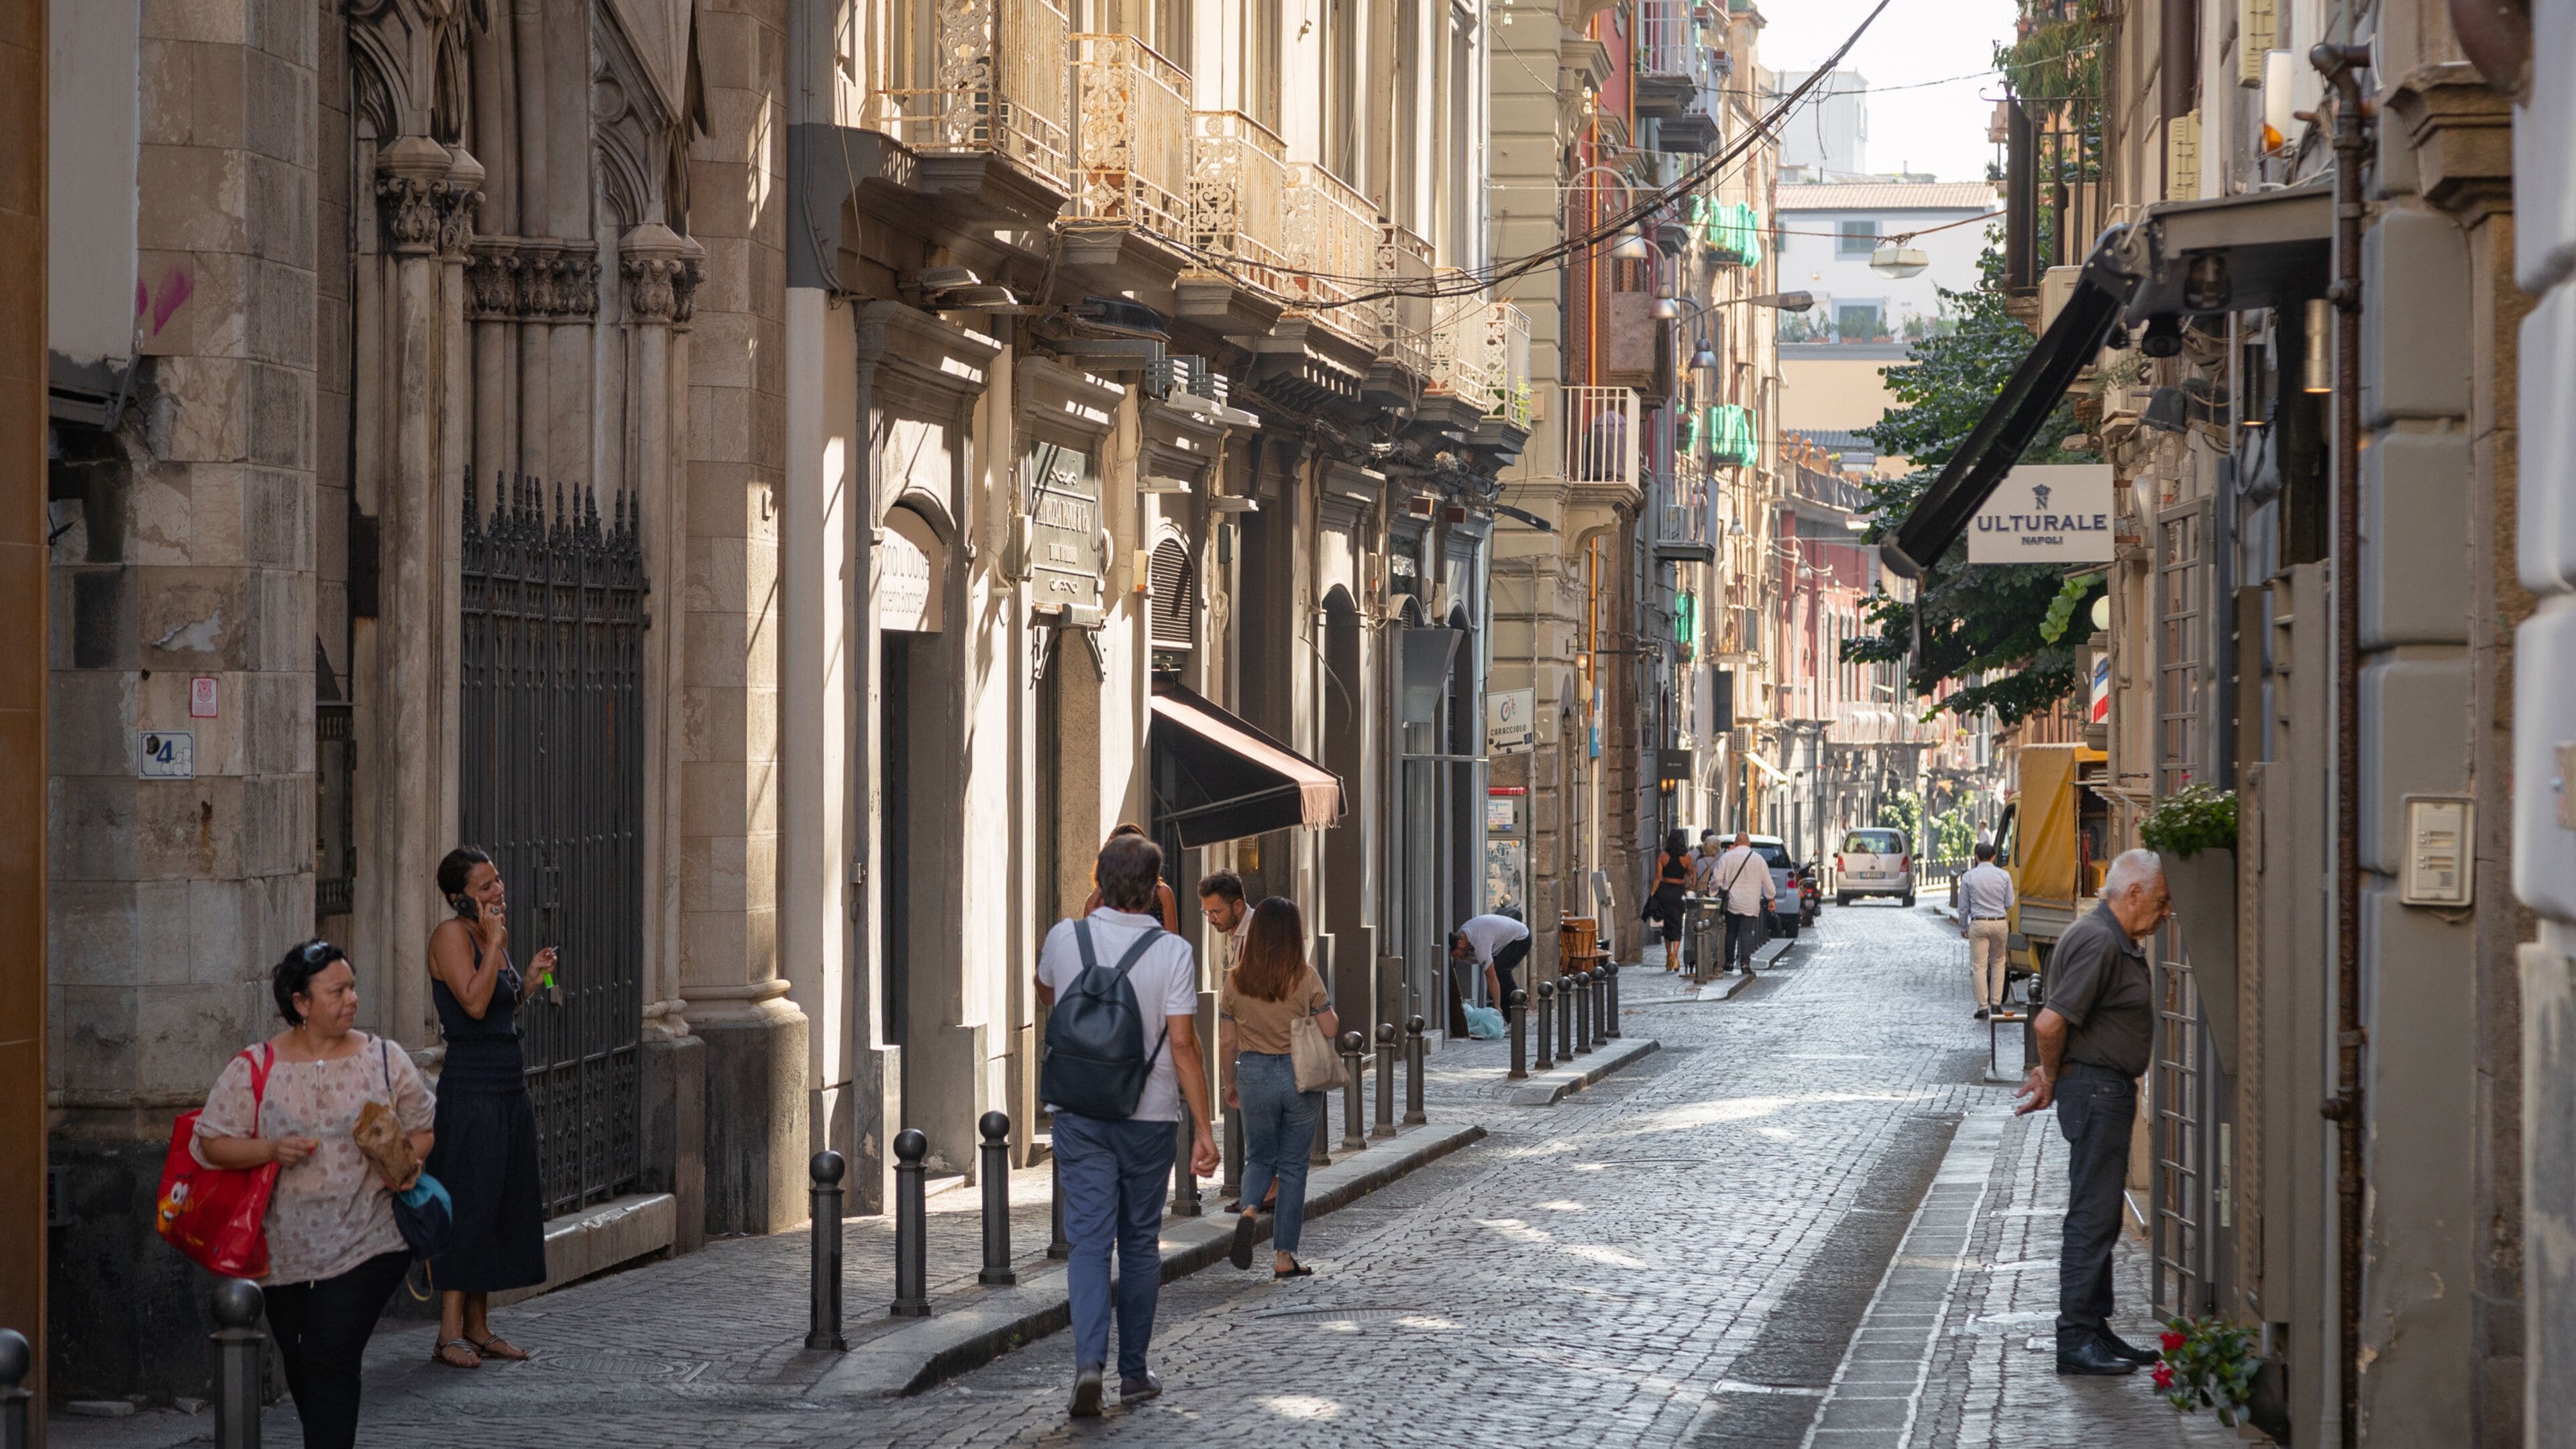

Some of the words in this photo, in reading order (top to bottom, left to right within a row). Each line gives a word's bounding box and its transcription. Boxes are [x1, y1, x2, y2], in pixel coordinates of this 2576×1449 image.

[2035, 496, 2048, 510] N
[1977, 514, 2108, 531] ULTURALE
[2021, 536, 2063, 545] NAPOLI
[1490, 724, 1527, 737] CARACCIOLO
[156, 740, 173, 763] 4
